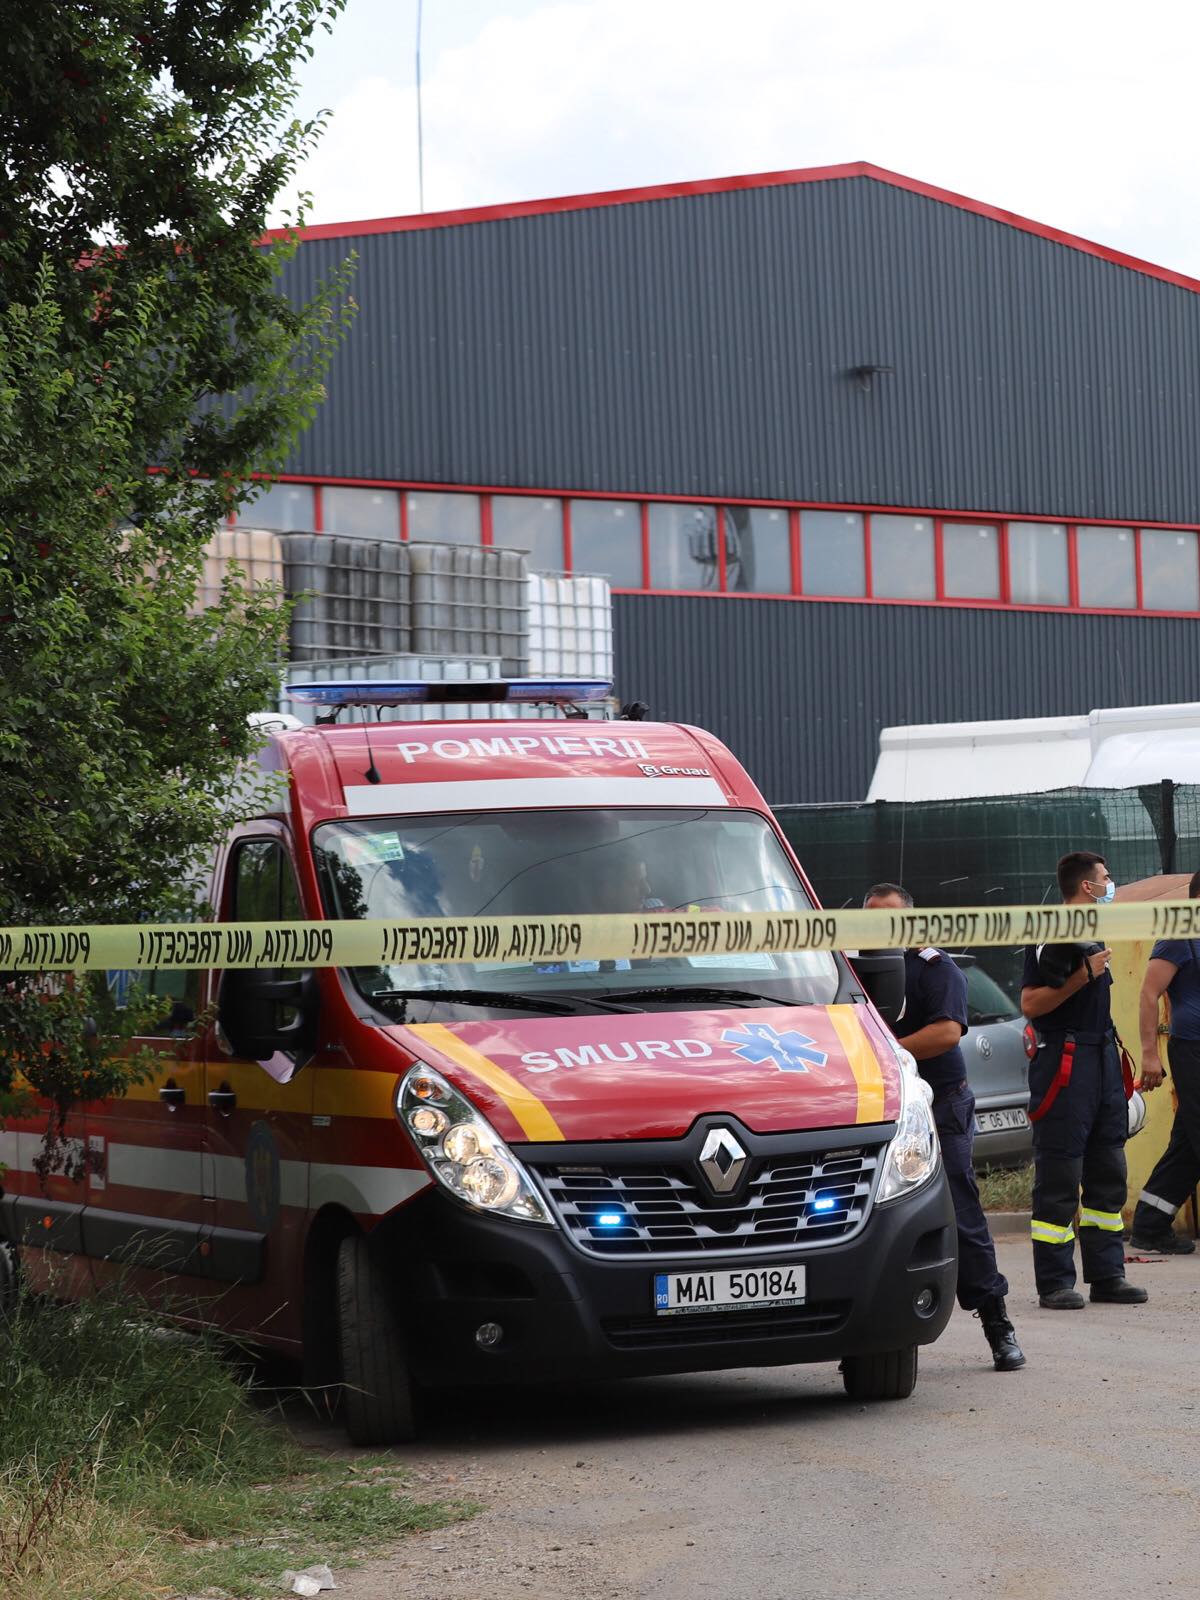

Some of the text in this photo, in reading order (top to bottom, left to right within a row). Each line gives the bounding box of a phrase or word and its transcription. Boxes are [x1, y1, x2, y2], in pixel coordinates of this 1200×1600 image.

[397, 736, 651, 764] POMPIERII
[662, 765, 710, 777] Gruau
[520, 1039, 713, 1074] SMURD
[989, 1112, 1003, 1128] 06
[656, 1269, 798, 1305] RO MAI 50184
